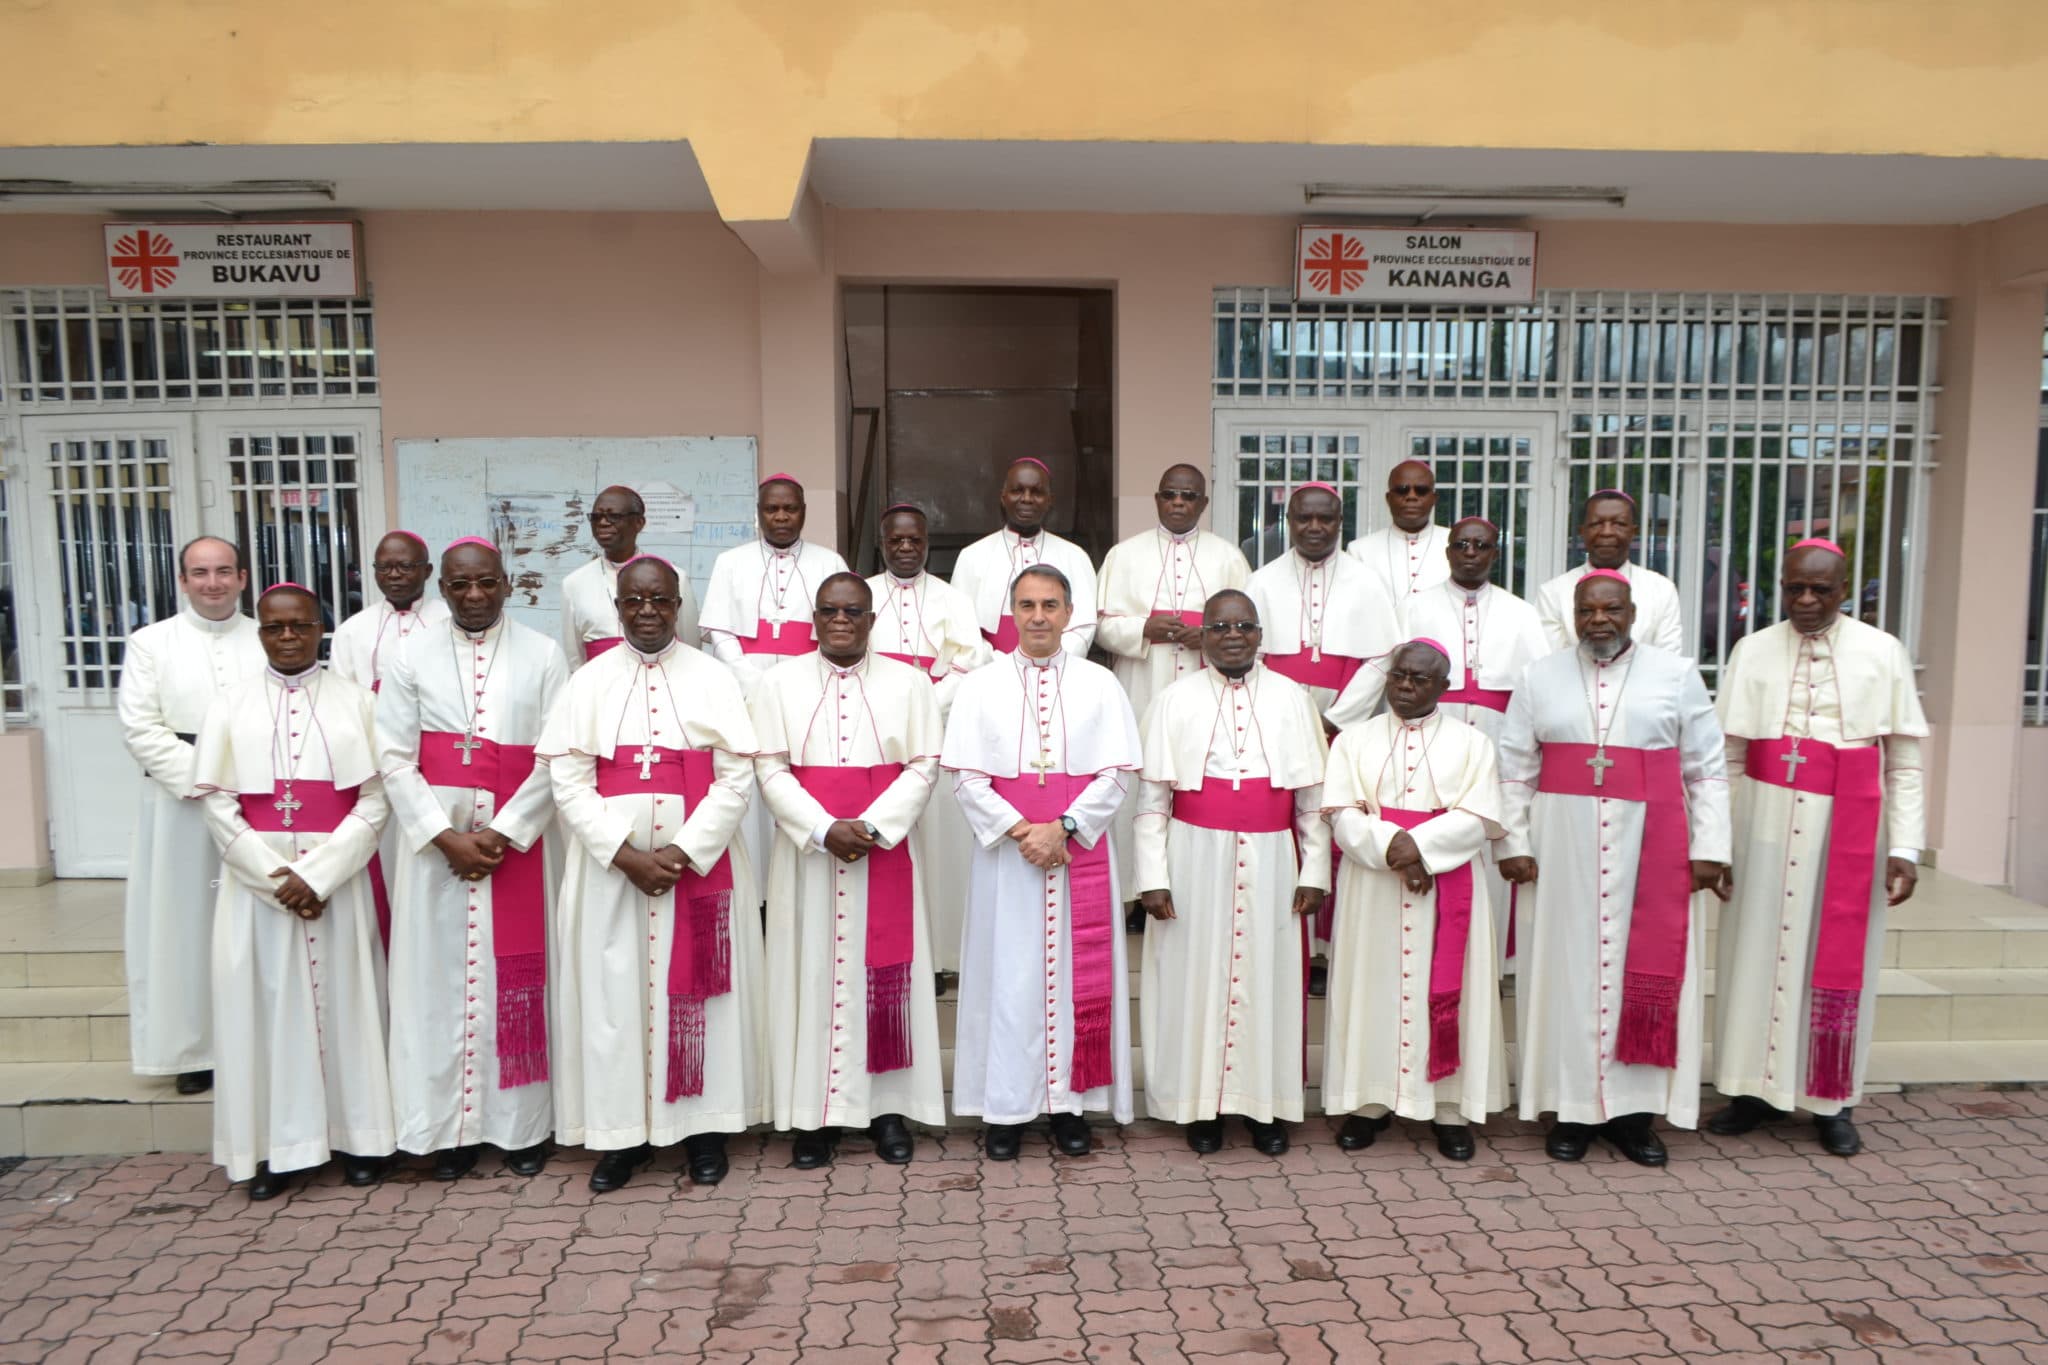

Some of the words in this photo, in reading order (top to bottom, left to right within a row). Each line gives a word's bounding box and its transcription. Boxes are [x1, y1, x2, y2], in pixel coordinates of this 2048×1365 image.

[217, 234, 312, 246] RESTAURANT
[1406, 236, 1462, 249] SALON
[184, 251, 239, 260] PROVINCE
[242, 250, 333, 260] ECCLESIASTIQUE
[336, 250, 351, 259] DE
[1373, 255, 1425, 264] PROVINCE
[1428, 255, 1515, 266] ECCLESIASTIQUE
[1518, 257, 1532, 266] DE
[213, 265, 321, 283] BUKAVU
[1388, 270, 1512, 288] KANANGA
